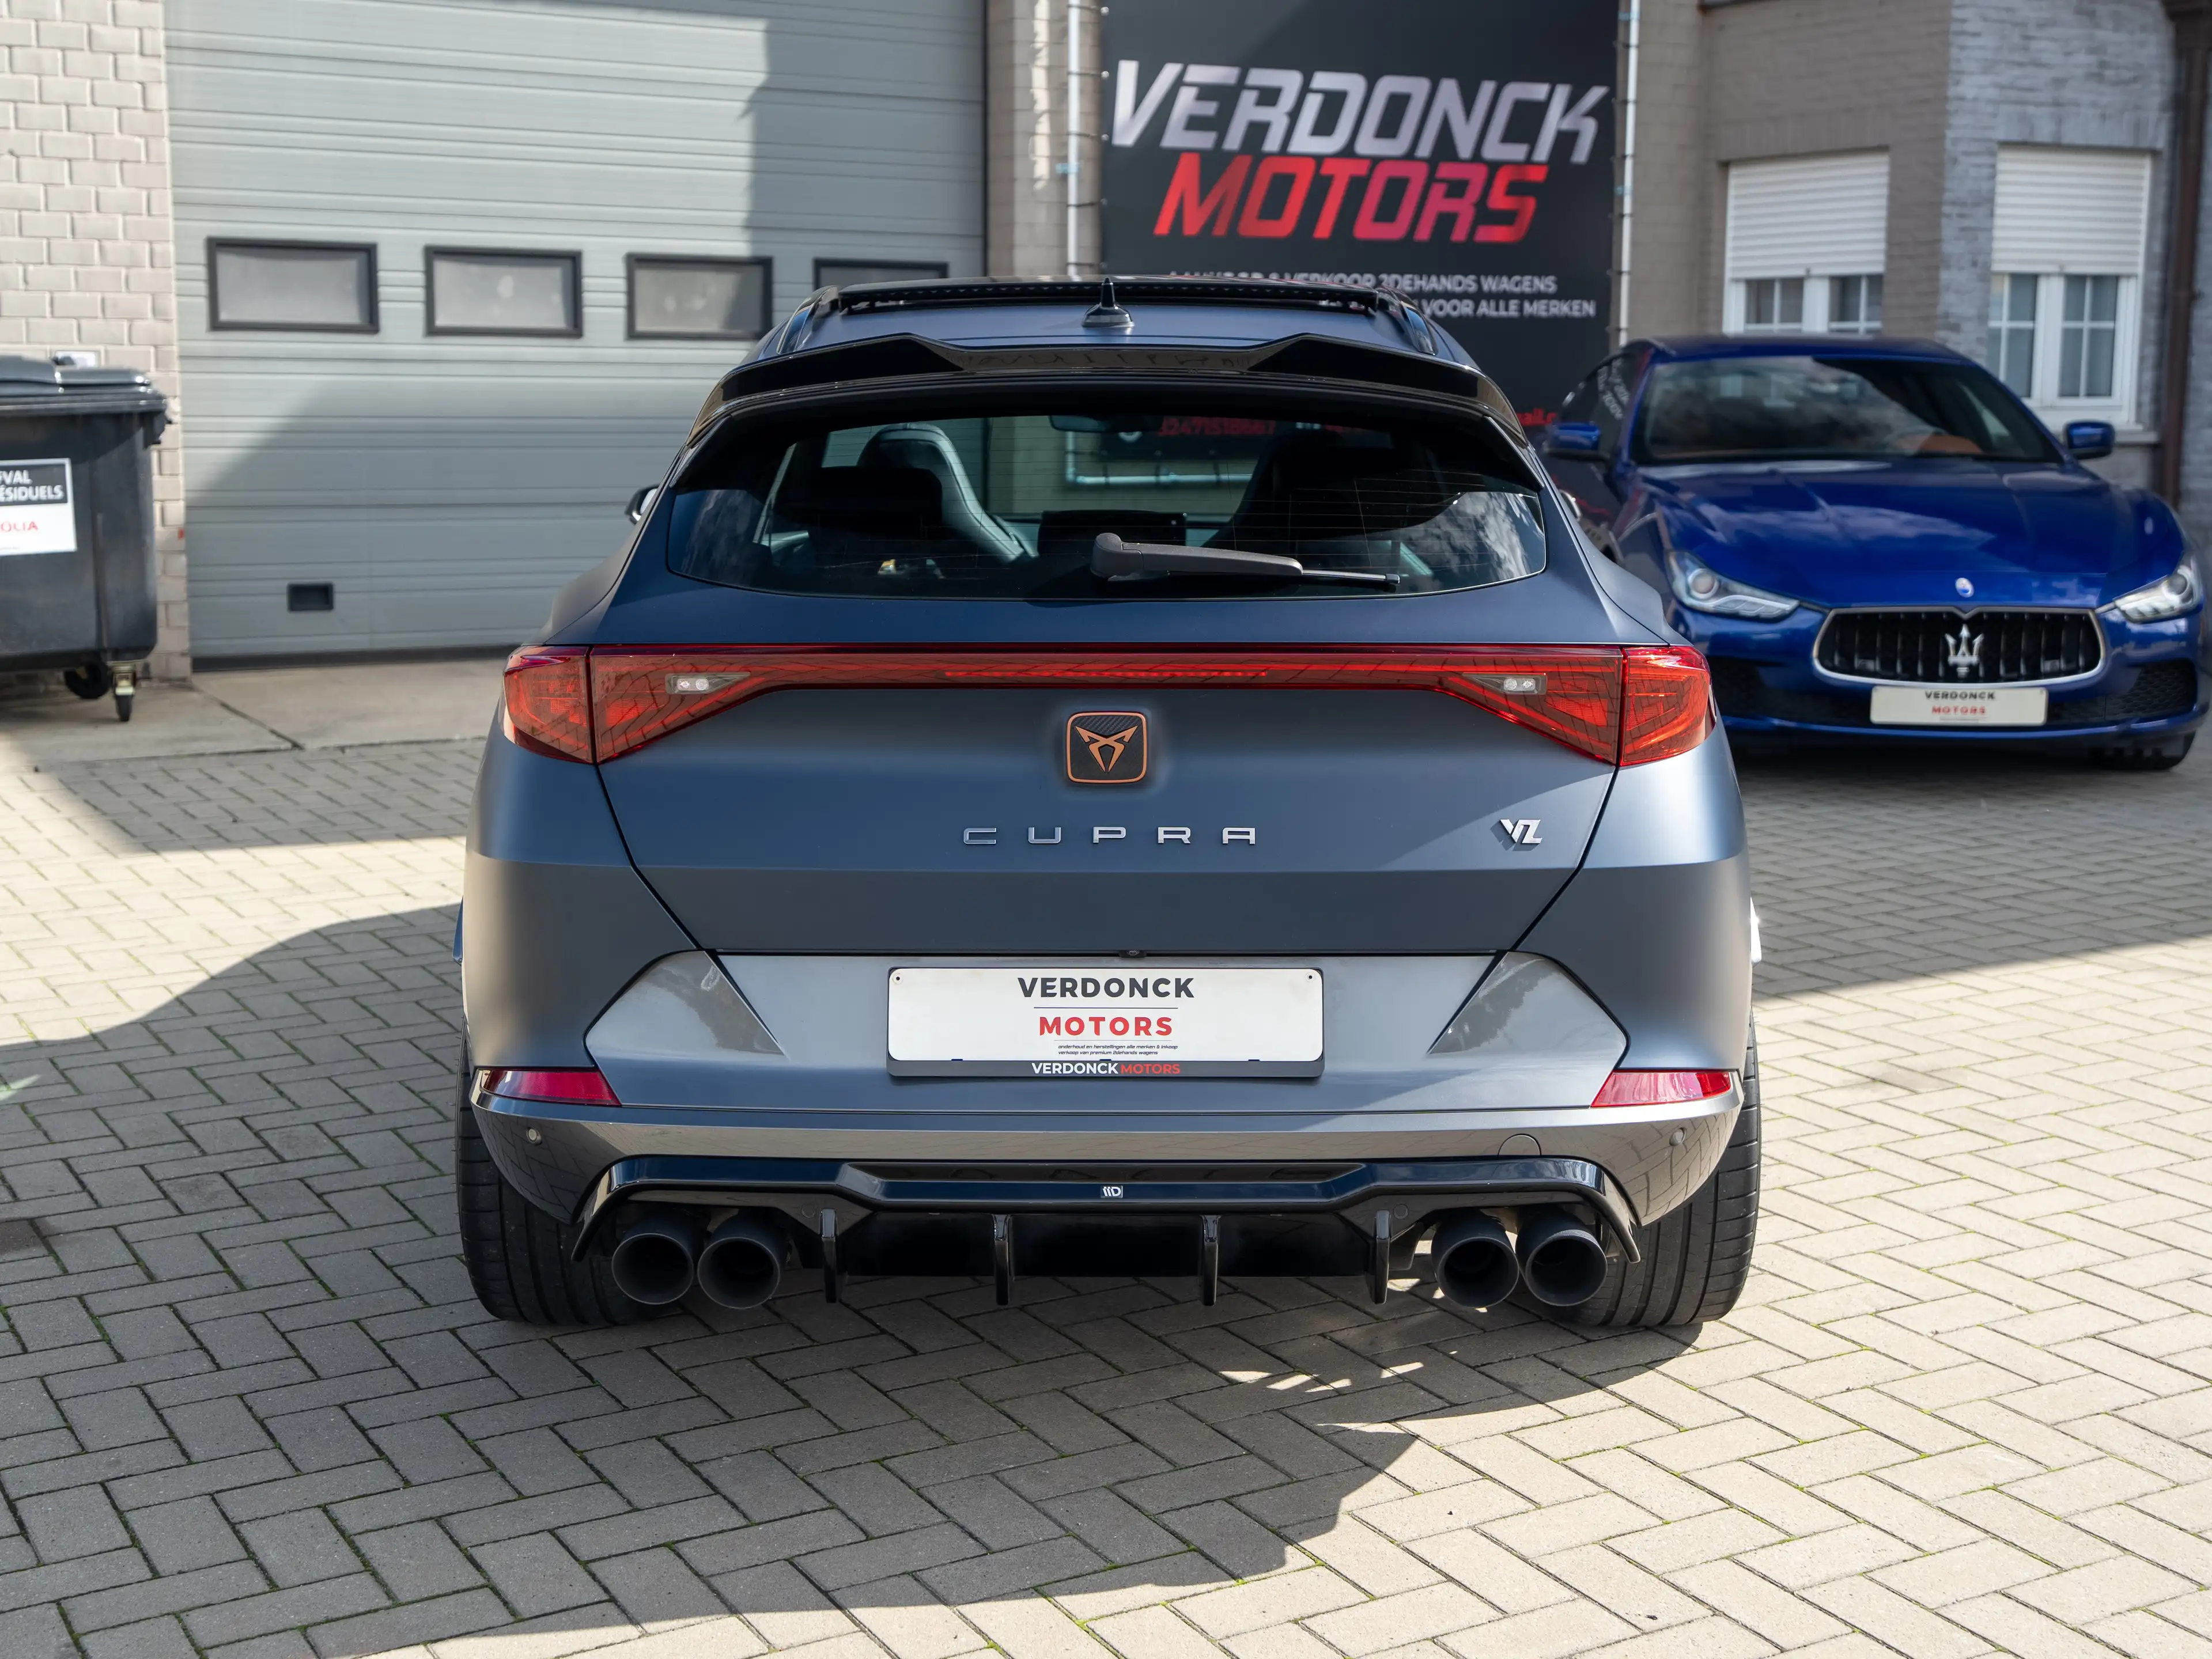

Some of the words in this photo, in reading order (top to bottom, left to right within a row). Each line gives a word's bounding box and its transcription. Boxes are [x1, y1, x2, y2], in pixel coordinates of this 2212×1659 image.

[1111, 59, 1609, 165] VERDONCK
[1154, 152, 1549, 243] MOTORS
[1480, 275, 1558, 294] WAGENS
[1421, 298, 1475, 317] VOOR
[1476, 299, 1521, 317] ALLE
[1523, 299, 1597, 317] MERKEN
[1925, 691, 1995, 700] VERDONCK
[1931, 705, 1986, 715] MOTORS
[963, 827, 1256, 845] CUPRA
[1500, 819, 1543, 844] VZ
[1017, 977, 1194, 998] VERDONCK
[1039, 1017, 1173, 1036] MOTORS
[1031, 1062, 1119, 1075] VERDONCK
[1120, 1063, 1181, 1075] MOTORS
